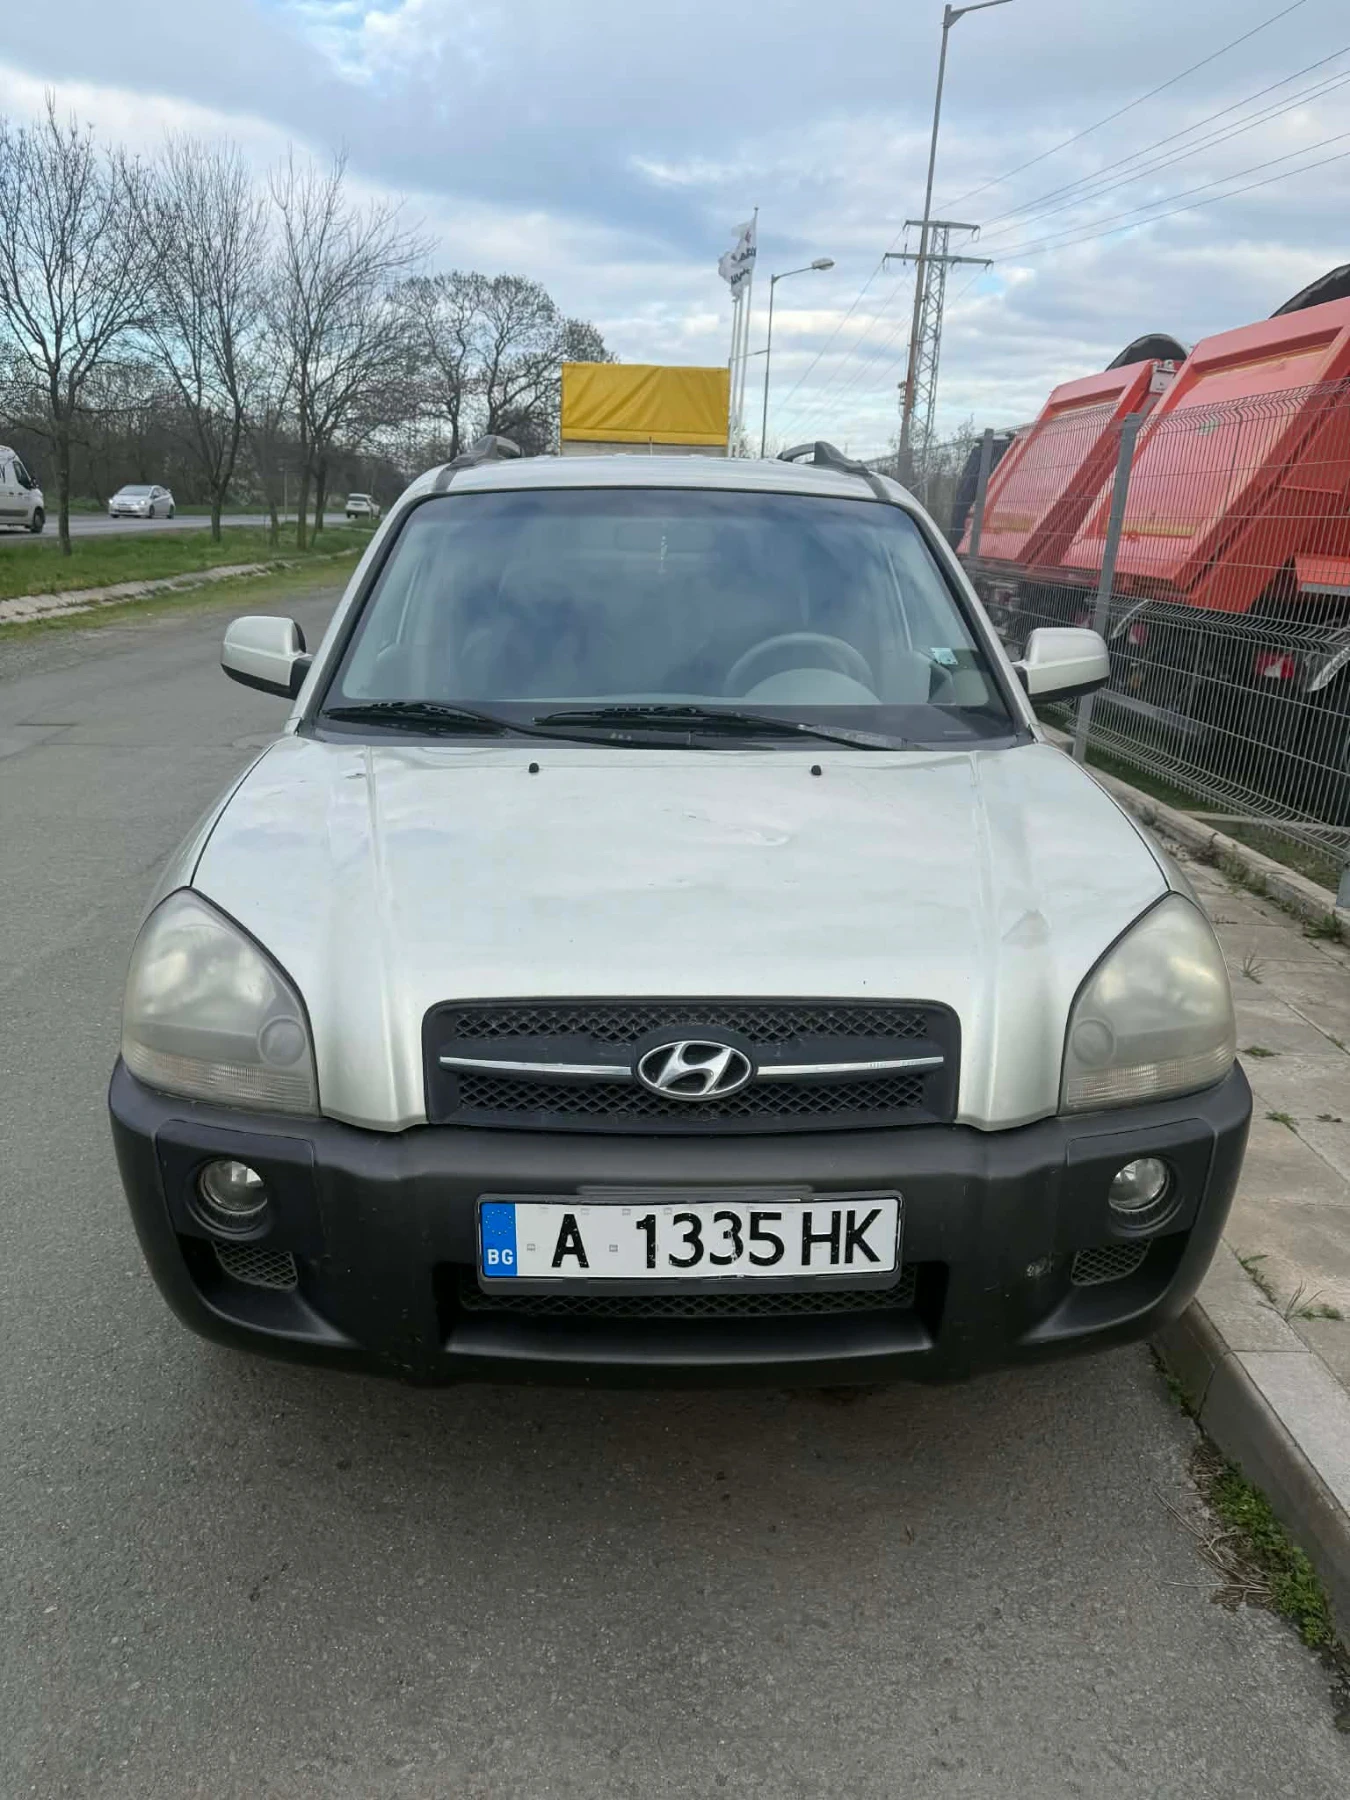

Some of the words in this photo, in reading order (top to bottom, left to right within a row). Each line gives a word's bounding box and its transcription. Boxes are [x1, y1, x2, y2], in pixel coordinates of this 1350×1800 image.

[487, 1248, 514, 1266] BG
[551, 1213, 590, 1269] A
[636, 1210, 785, 1269] 1335
[801, 1208, 883, 1266] HK
